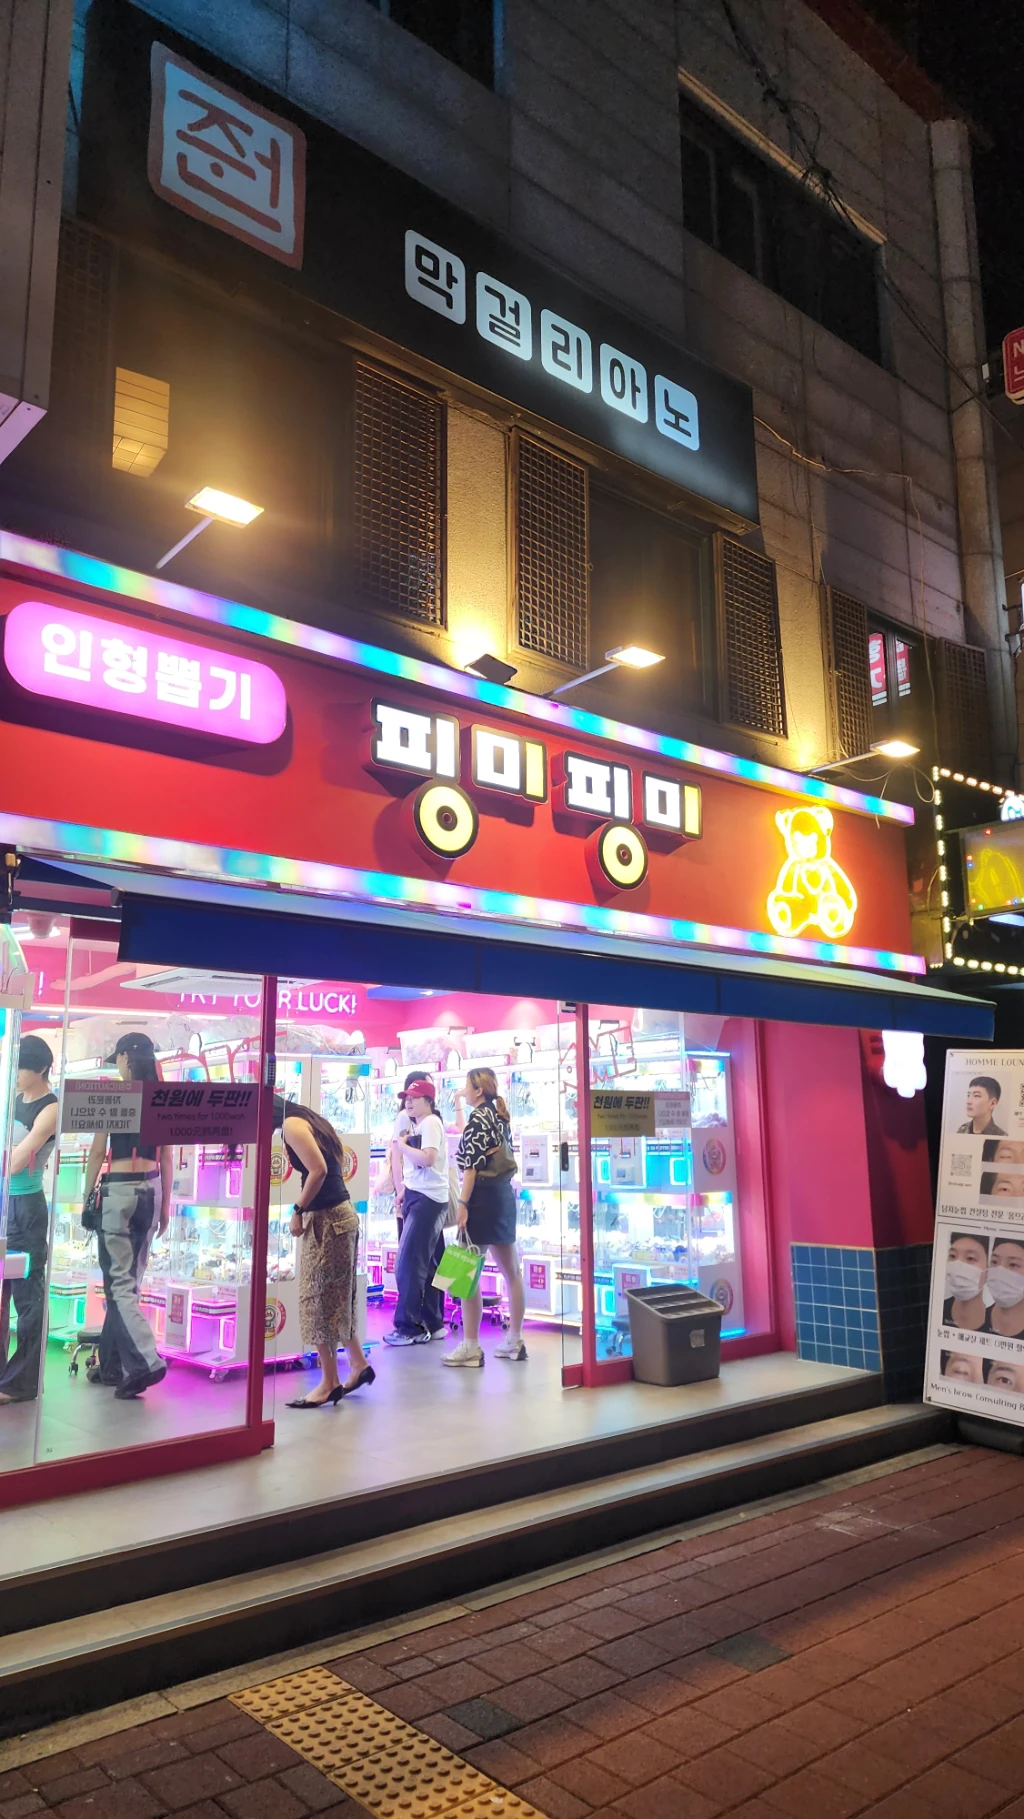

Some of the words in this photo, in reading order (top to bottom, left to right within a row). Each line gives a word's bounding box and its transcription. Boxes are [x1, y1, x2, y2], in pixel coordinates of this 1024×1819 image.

[414, 244, 693, 439] 막걸리아노
[41, 623, 252, 721] 인형뽑기
[298, 990, 357, 1015] LUCK!
[965, 1058, 998, 1067] HOMME
[150, 1088, 205, 1108] 천원에
[206, 1088, 253, 1108] 두판!!
[593, 1095, 624, 1110] 천원에
[625, 1095, 650, 1110] 두판!!
[930, 1382, 952, 1394] Men's
[953, 1388, 973, 1398] brow
[975, 1392, 1017, 1411] Consulting
